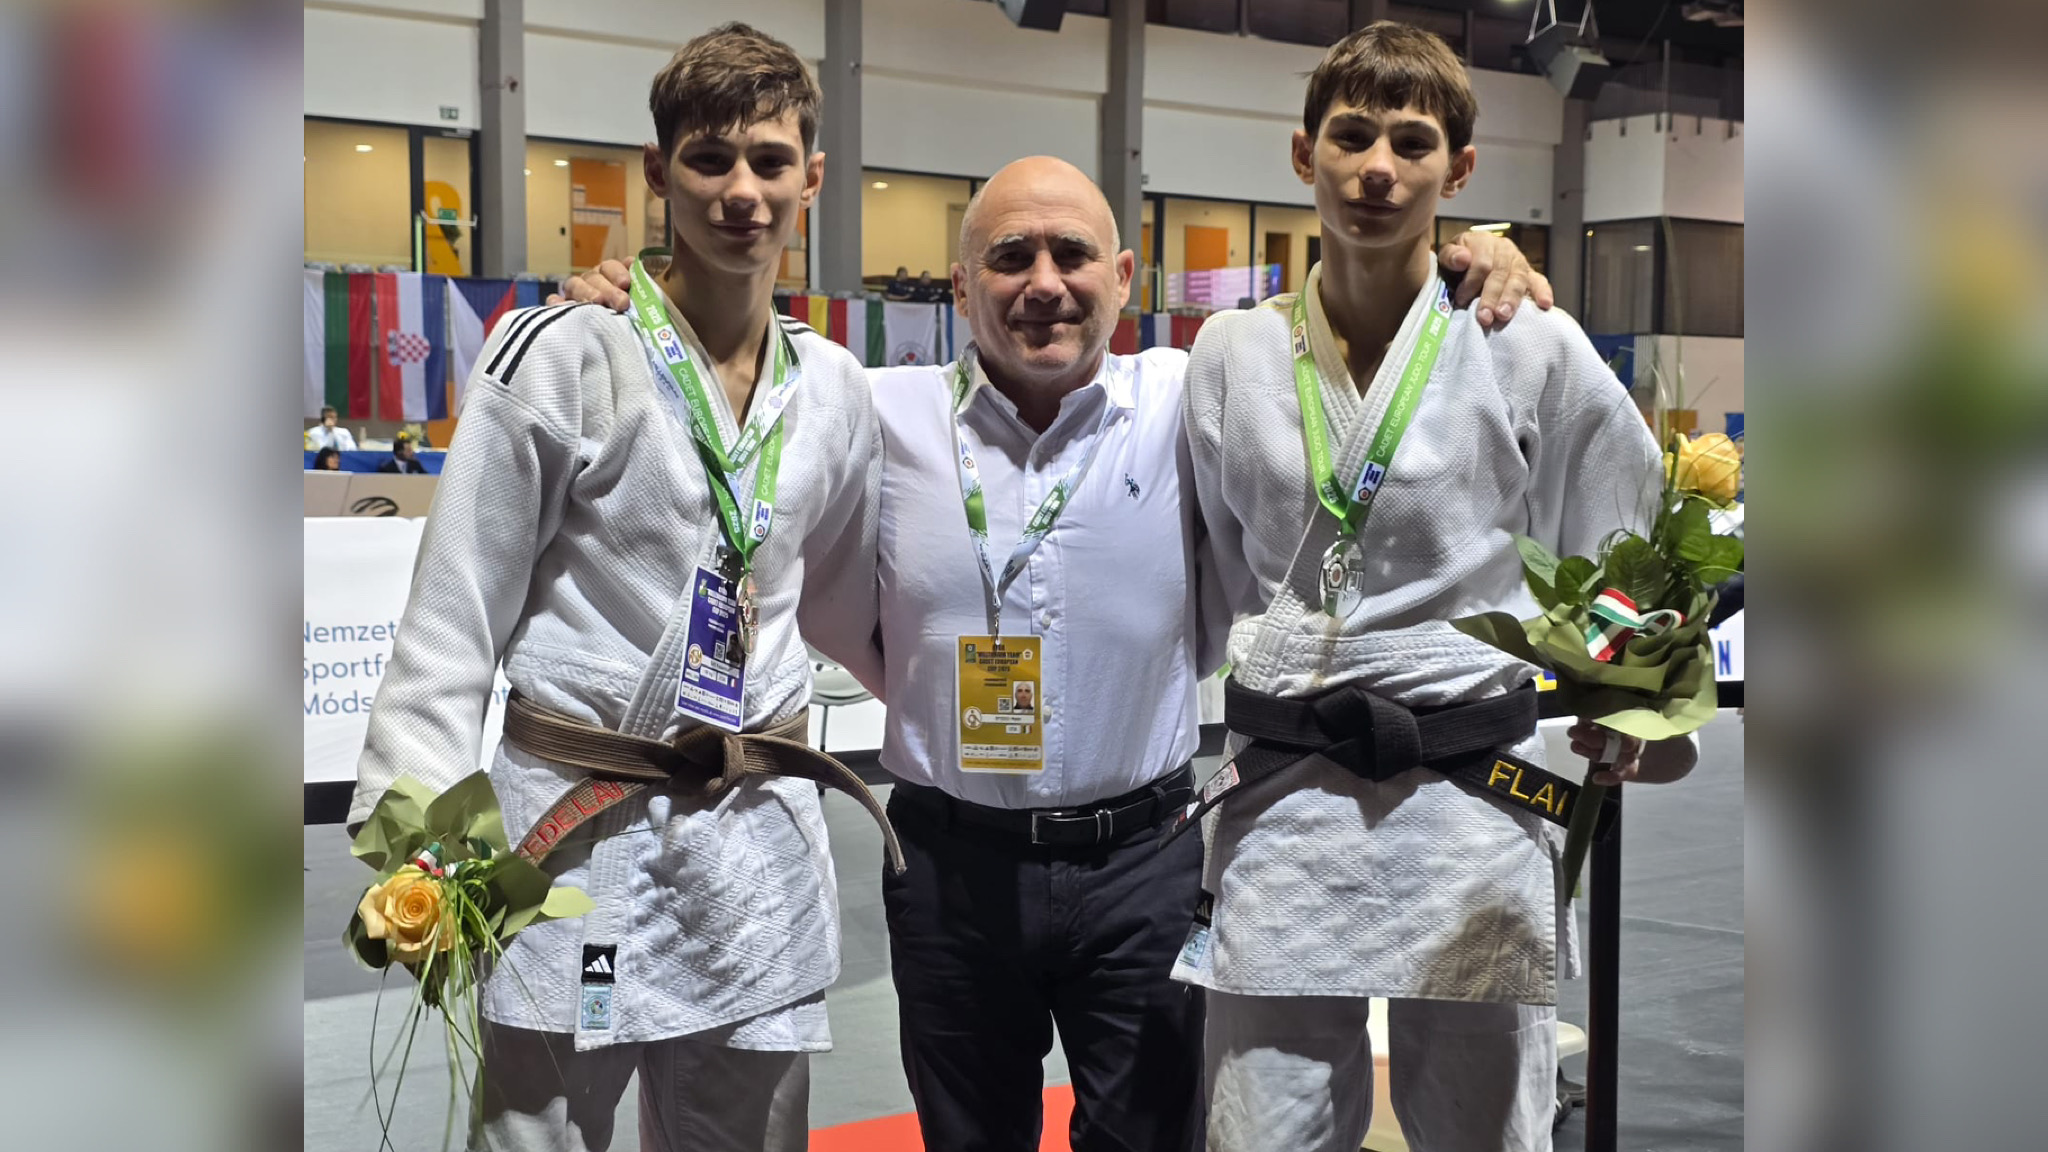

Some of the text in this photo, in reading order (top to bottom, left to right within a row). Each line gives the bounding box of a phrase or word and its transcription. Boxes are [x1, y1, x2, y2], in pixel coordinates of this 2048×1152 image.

[679, 368, 697, 397] CADET
[1376, 427, 1395, 458] CADET
[1391, 387, 1413, 428] EUROPEAN
[1409, 363, 1423, 386] JUDO
[1301, 360, 1312, 385] CADET
[1321, 481, 1339, 504] 2025
[762, 467, 772, 496] CADET
[729, 510, 741, 534] 2025
[1487, 760, 1569, 816] FLAI
